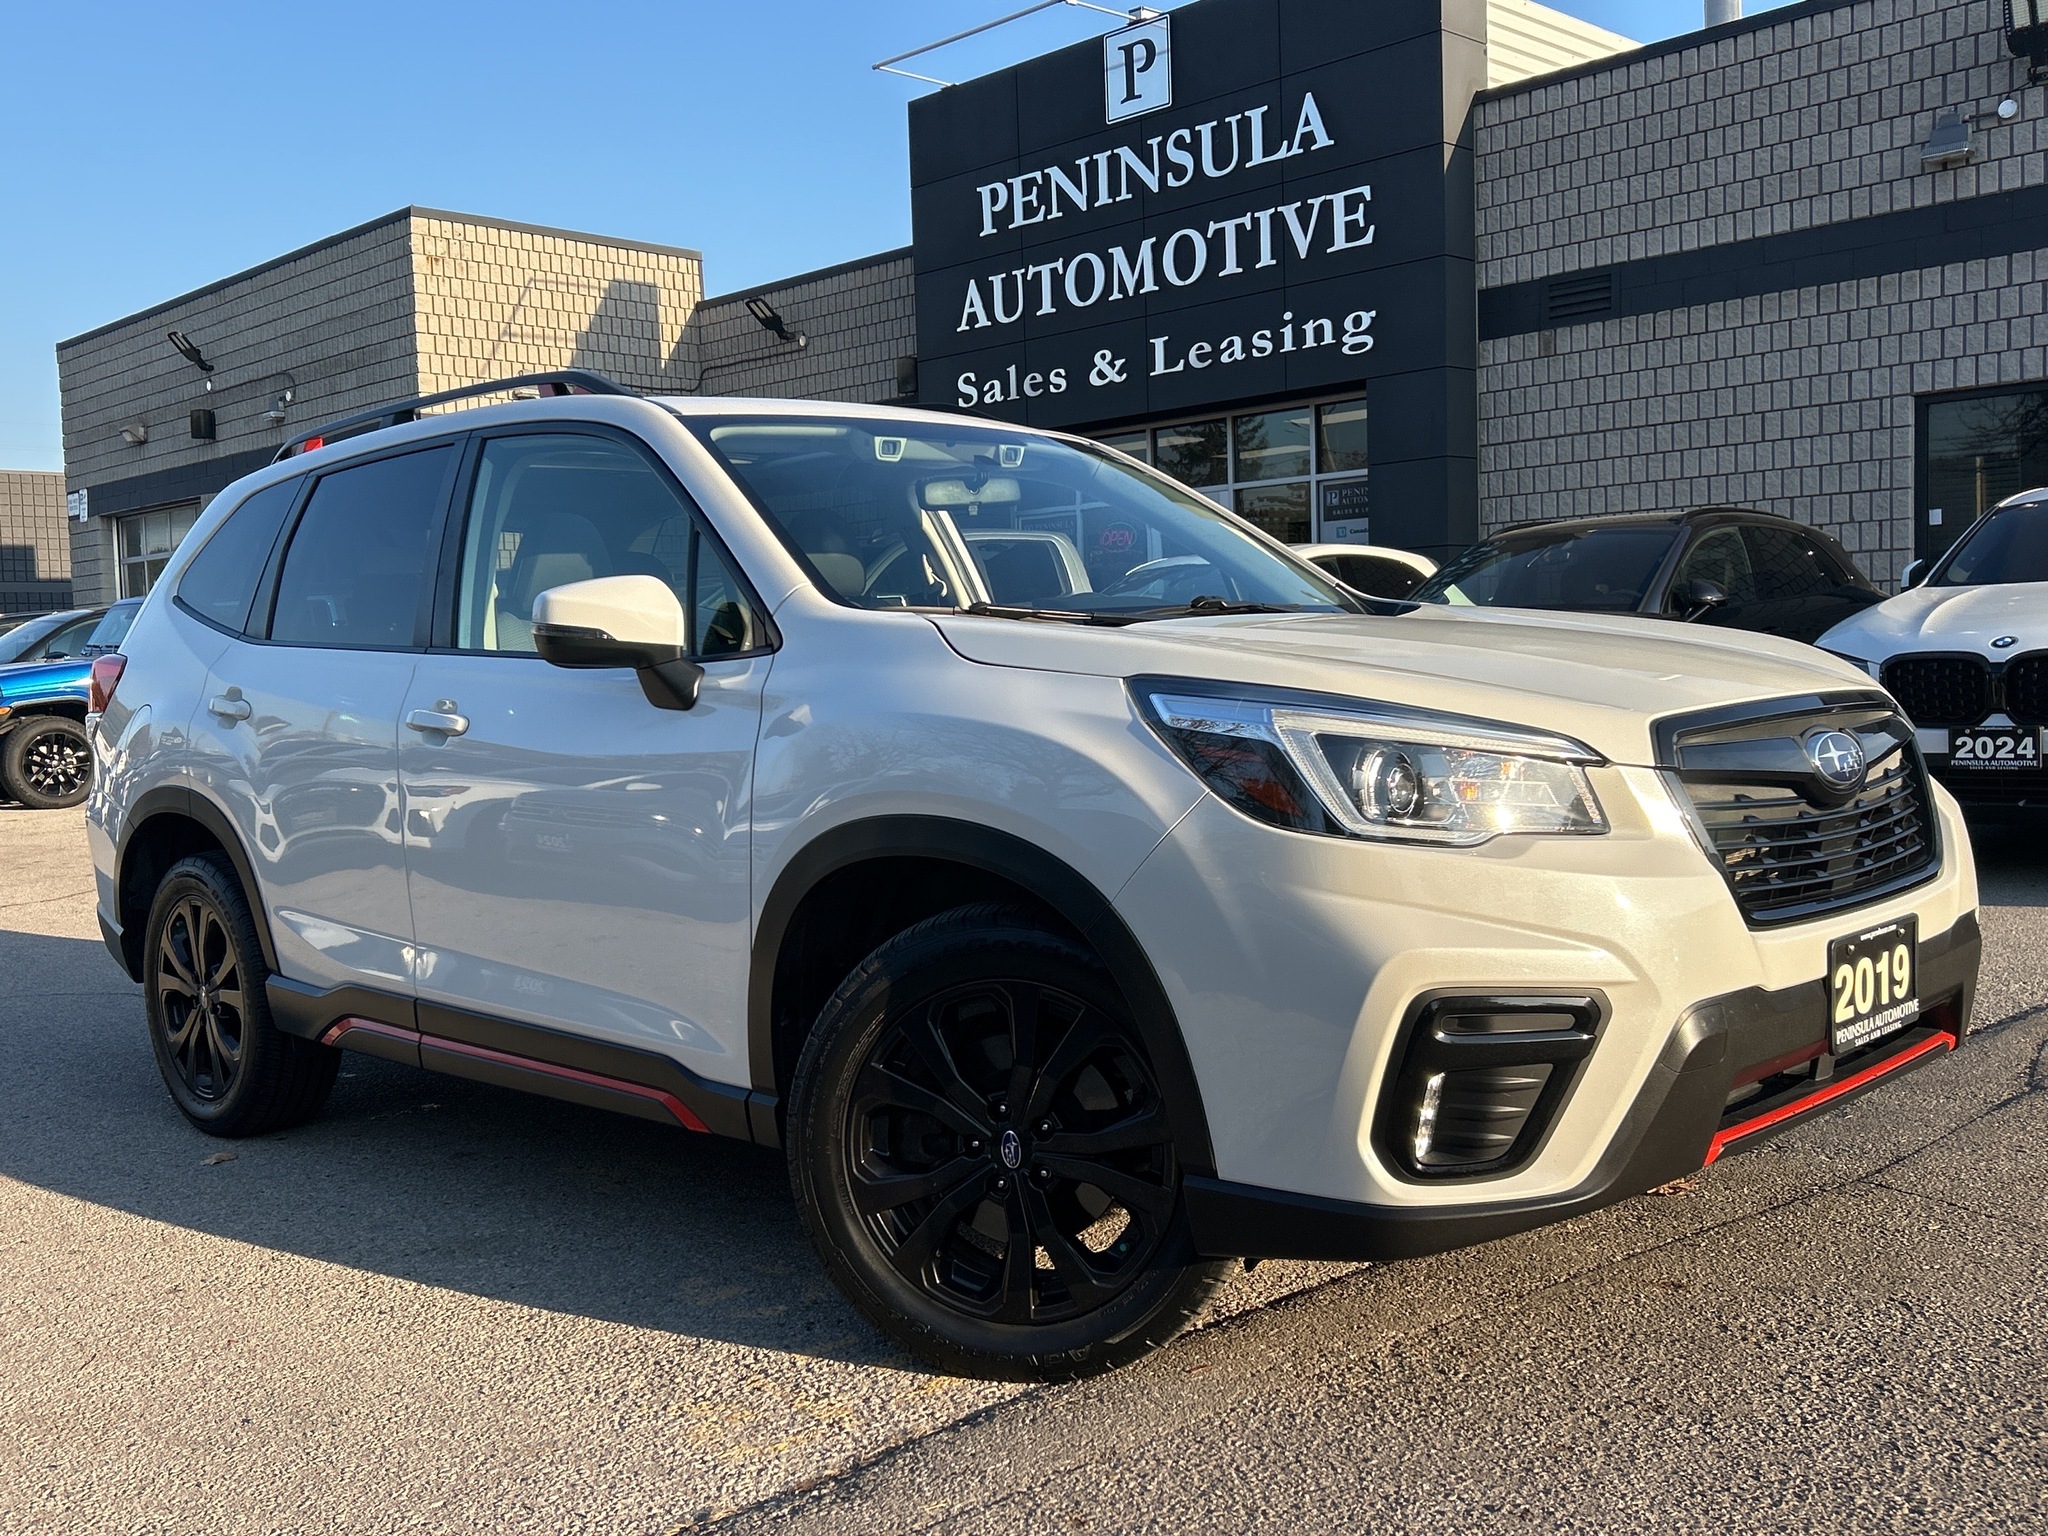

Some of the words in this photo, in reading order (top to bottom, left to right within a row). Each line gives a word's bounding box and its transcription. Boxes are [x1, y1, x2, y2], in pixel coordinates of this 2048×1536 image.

[1119, 37, 1157, 105] P
[976, 91, 1335, 237] PENINSULA
[956, 185, 1376, 333] AUTOMOTIVE
[957, 363, 1068, 408] Sales
[1089, 349, 1128, 388] &
[1149, 309, 1377, 378] Leasing
[1100, 530, 1134, 545] OPEN
[1951, 759, 1990, 767] PENINSULA
[1990, 759, 2038, 767] AUTOMOTIVE
[1955, 736, 2035, 759] 2024
[1834, 944, 1910, 1023] 2019
[1836, 1017, 1875, 1045] PENINSULA
[1875, 998, 1920, 1029] AUTOMOTIVE
[1854, 1033, 1870, 1047] SALES
[1870, 1028, 1881, 1040] AND
[1881, 1020, 1902, 1038] LEASING
